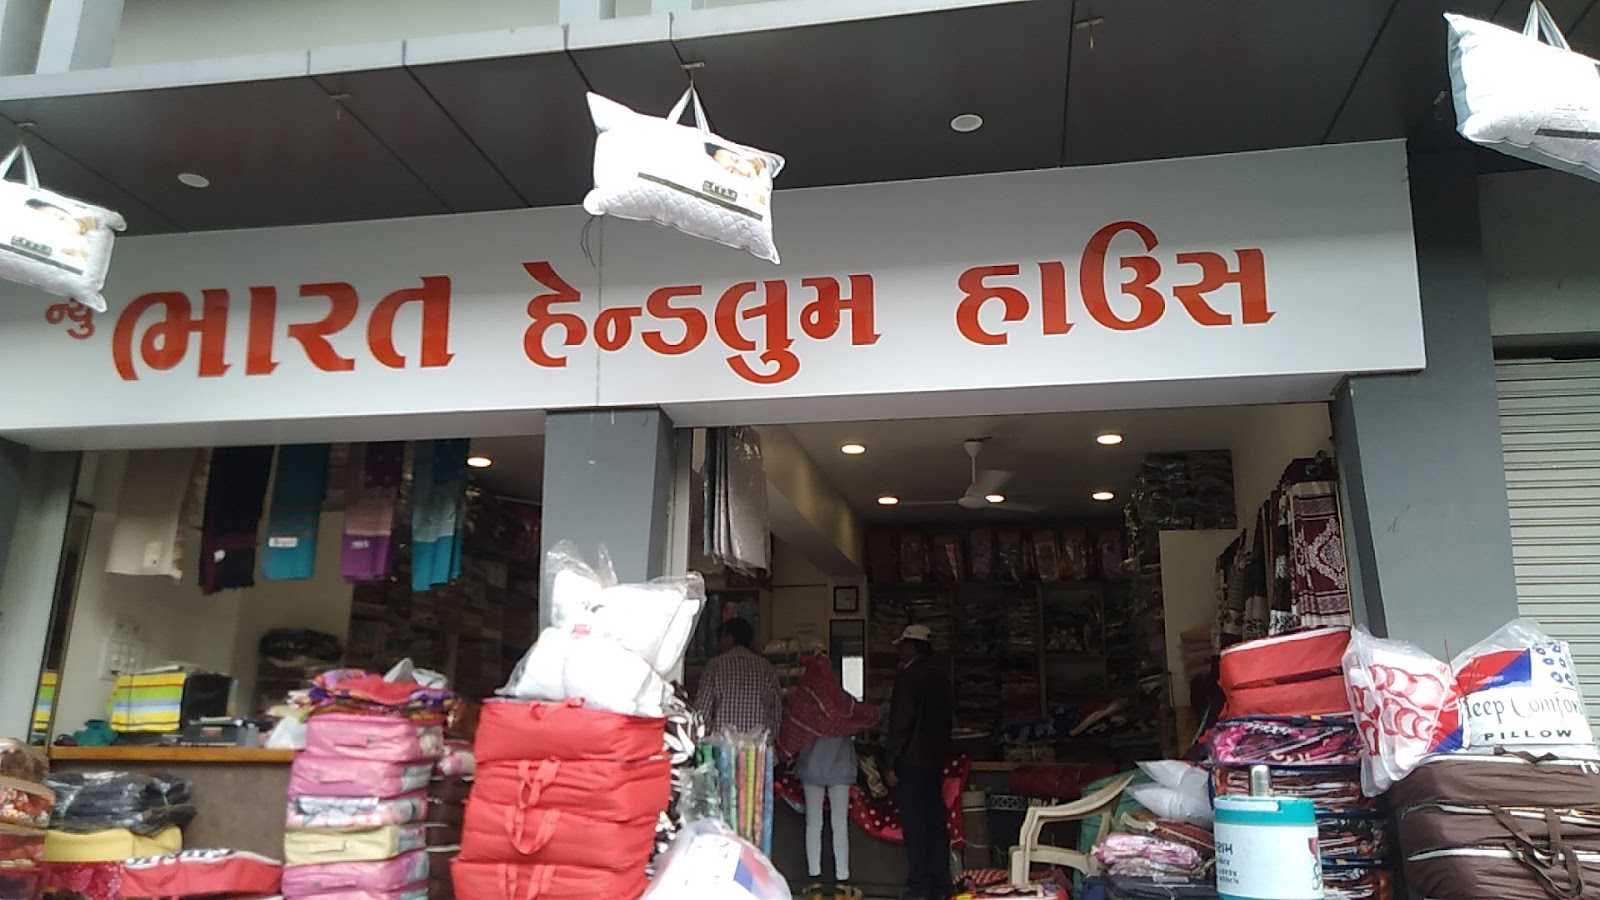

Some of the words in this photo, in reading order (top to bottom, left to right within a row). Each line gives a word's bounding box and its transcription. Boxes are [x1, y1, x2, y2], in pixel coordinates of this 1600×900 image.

[113, 276, 454, 382] ભારત
[524, 262, 881, 385] હેન્ડલુમ
[956, 220, 1276, 346] હાઉસ
[1464, 698, 1505, 724] leep
[1483, 729, 1573, 741] PILLOW
